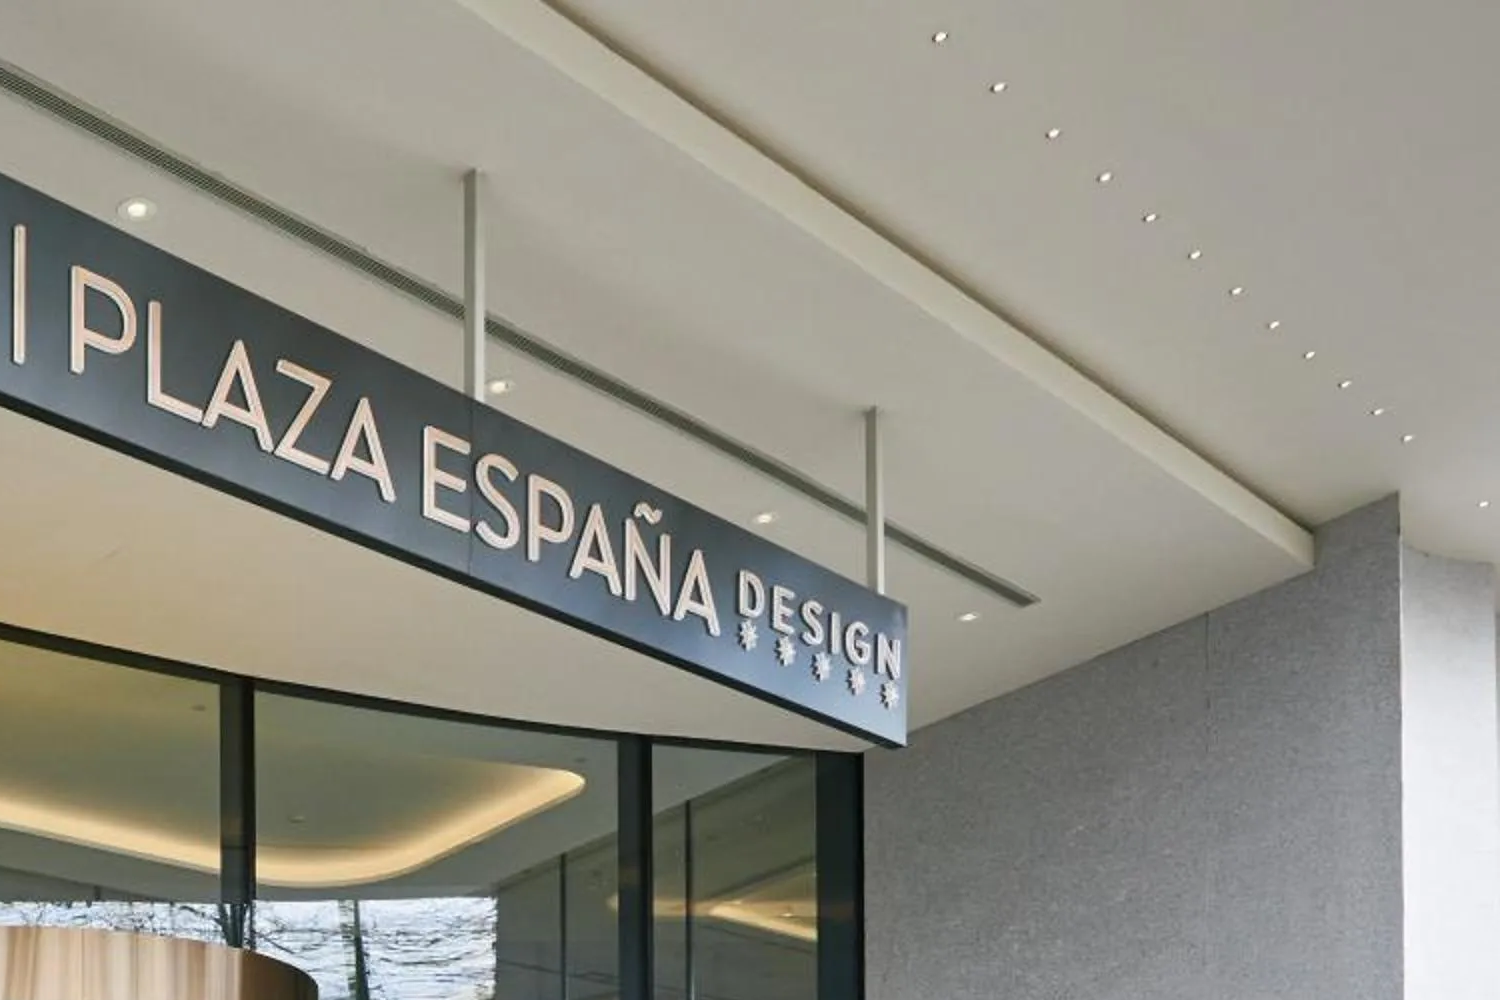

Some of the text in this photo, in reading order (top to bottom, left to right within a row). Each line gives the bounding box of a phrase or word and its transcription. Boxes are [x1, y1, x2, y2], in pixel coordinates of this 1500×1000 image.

[70, 265, 396, 503] PLAZA
[422, 424, 722, 637] ESPAÑA
[738, 569, 901, 680] DESIGN
